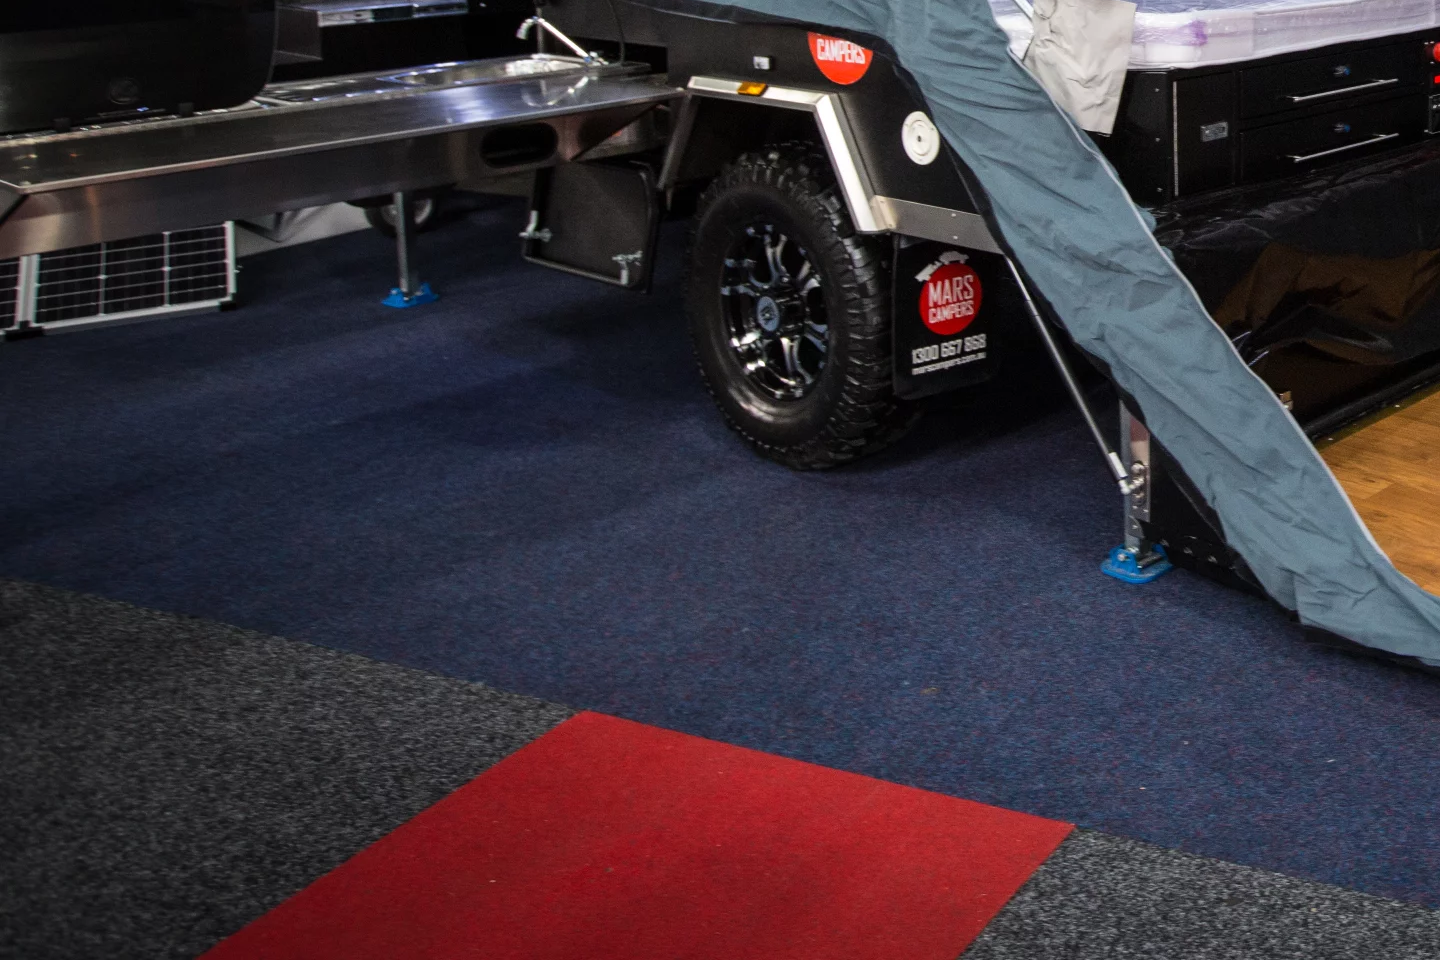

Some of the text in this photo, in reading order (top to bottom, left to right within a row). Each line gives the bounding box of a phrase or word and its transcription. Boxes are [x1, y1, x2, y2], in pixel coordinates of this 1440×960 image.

[816, 38, 866, 65] CAMPERS
[928, 274, 974, 307] MARS
[928, 300, 975, 324] CAMPERS
[912, 344, 939, 364] 1300
